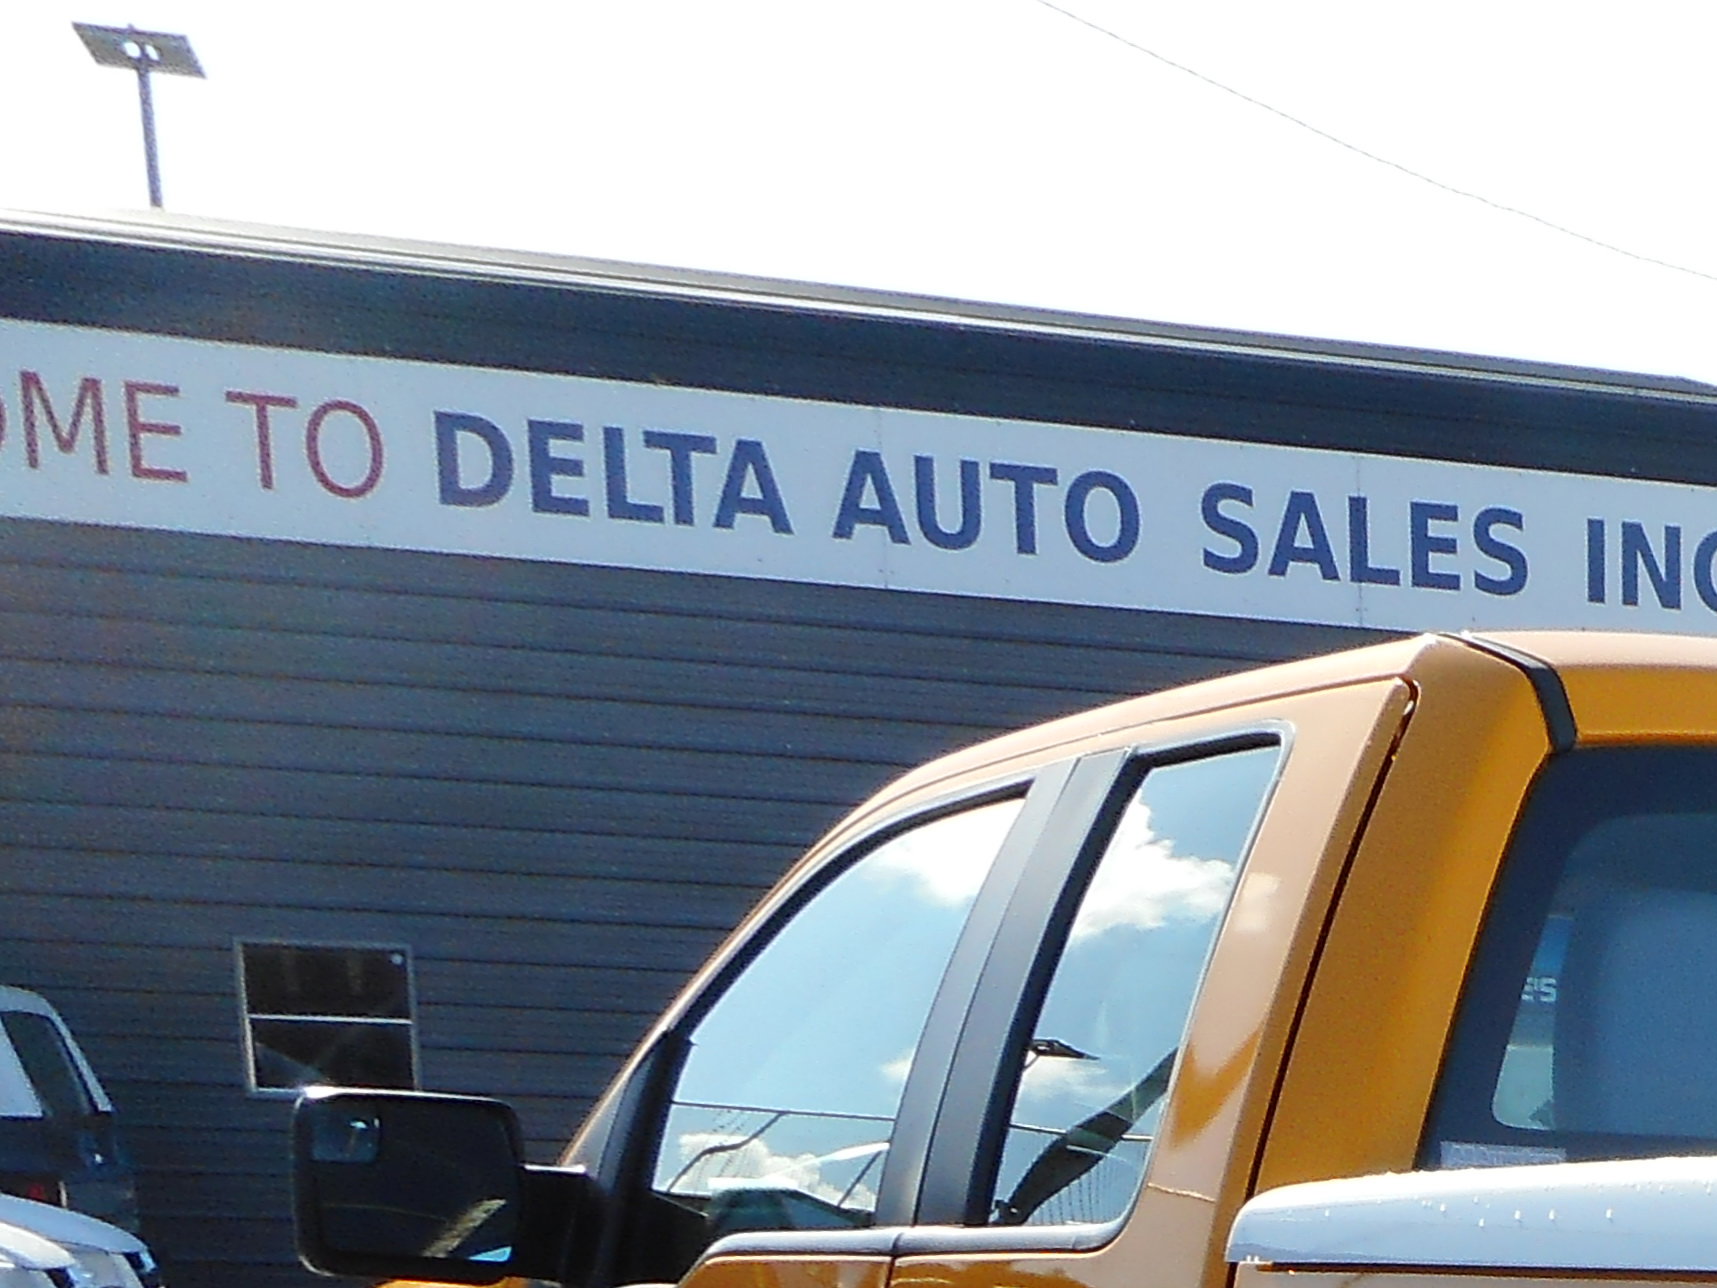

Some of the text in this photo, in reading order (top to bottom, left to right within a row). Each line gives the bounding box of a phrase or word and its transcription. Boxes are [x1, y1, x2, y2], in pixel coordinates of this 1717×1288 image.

[0, 369, 188, 484] ME
[225, 389, 385, 500] TO
[432, 409, 795, 536] DELTA
[831, 448, 1143, 564] AUTO
[1200, 481, 1530, 598] SALES
